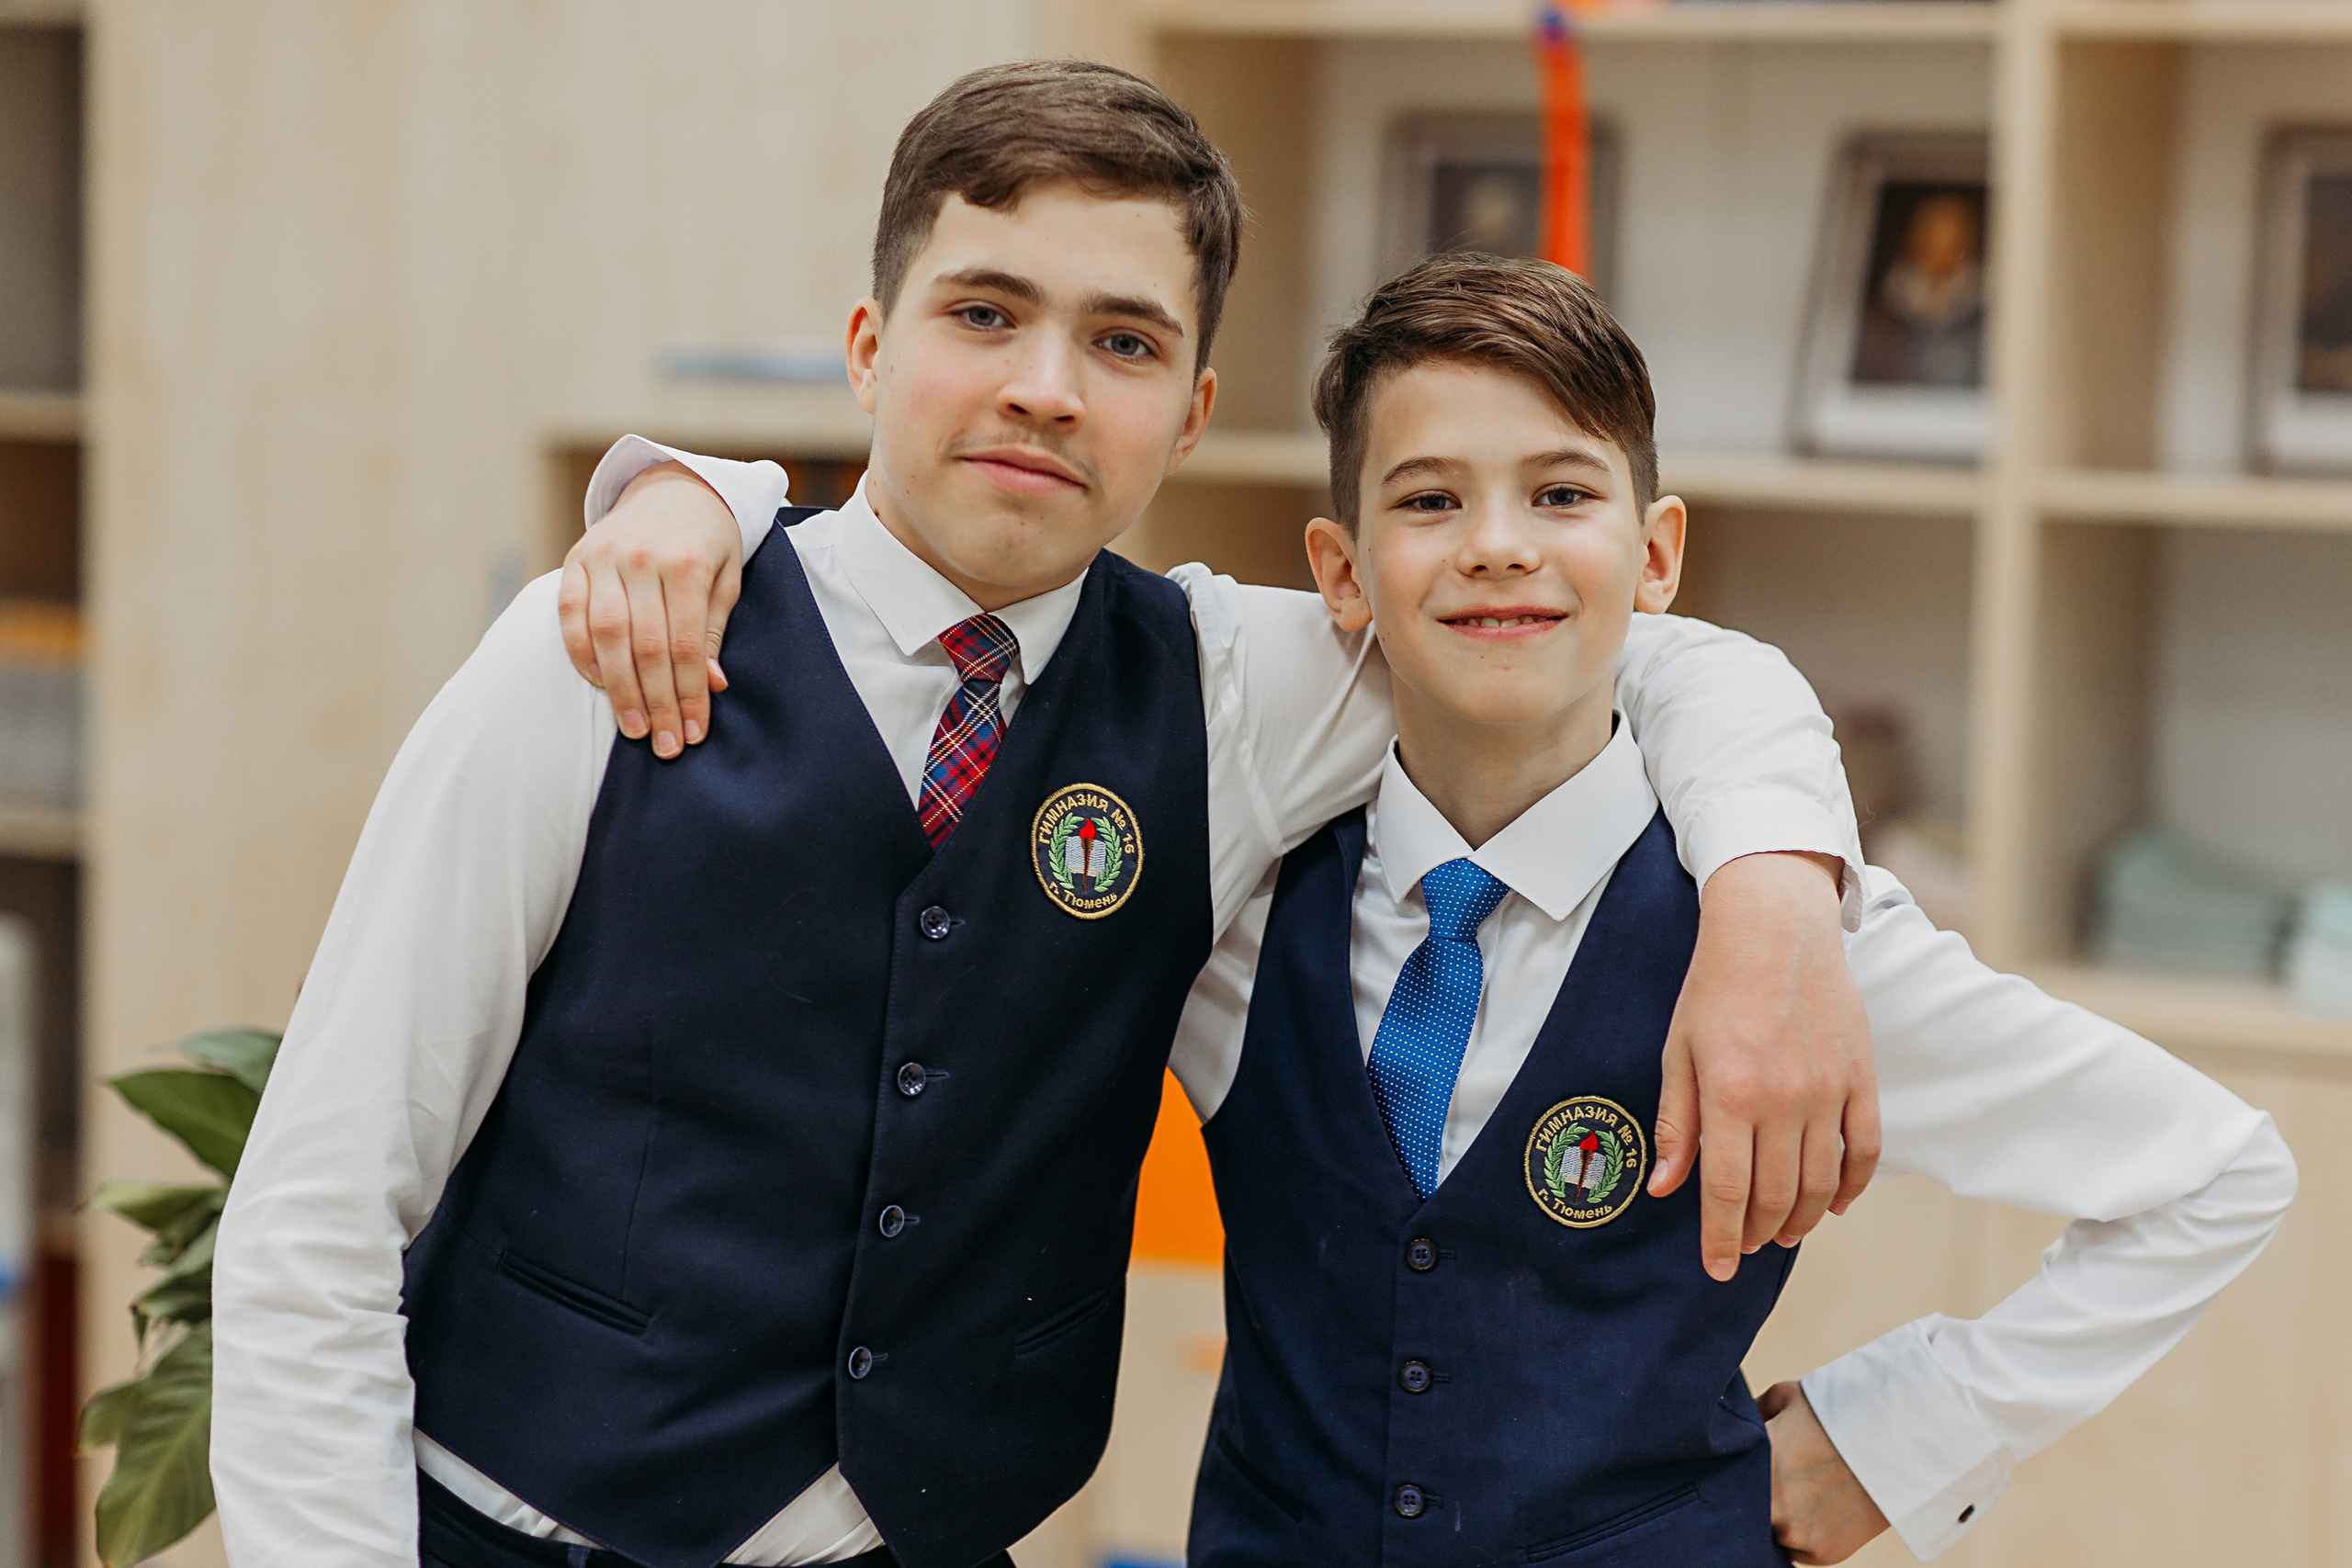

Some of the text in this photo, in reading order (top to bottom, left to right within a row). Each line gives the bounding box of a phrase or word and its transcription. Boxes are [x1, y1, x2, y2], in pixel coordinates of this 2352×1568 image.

[1038, 794, 1135, 854] ГИМНАЗИЯ № 16
[1063, 889, 1118, 909] Тюмень
[1535, 1105, 1637, 1168] ГИМНАЗИЯ № 16
[1553, 1198, 1613, 1220] Тюмень
